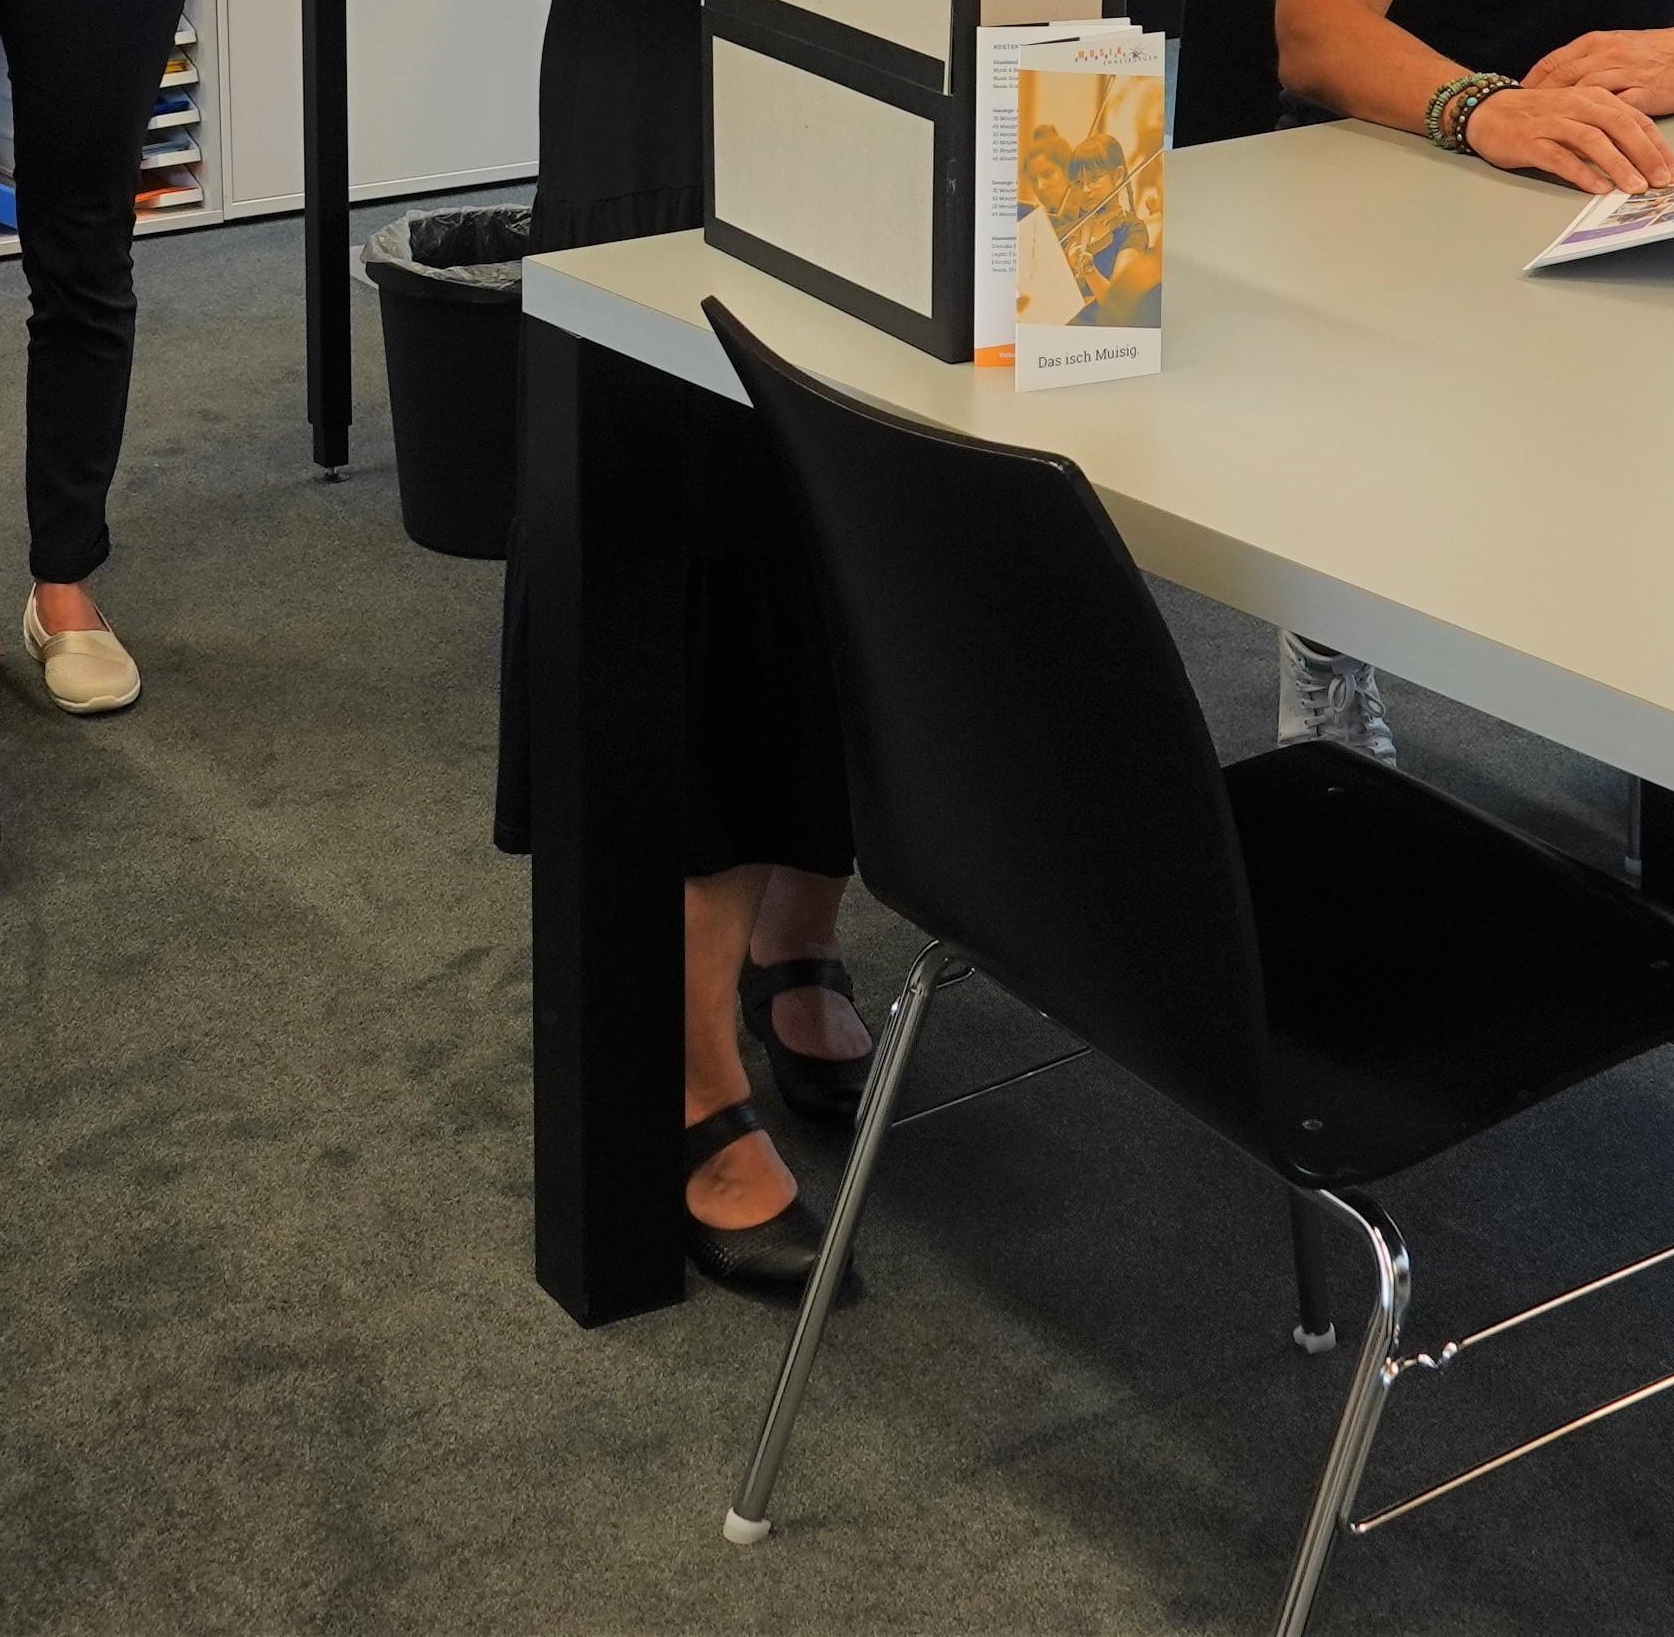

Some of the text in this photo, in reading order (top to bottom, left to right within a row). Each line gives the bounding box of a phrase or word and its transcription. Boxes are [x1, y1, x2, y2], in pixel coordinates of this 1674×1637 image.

[1038, 345, 1140, 369] Das isch Muisig.
